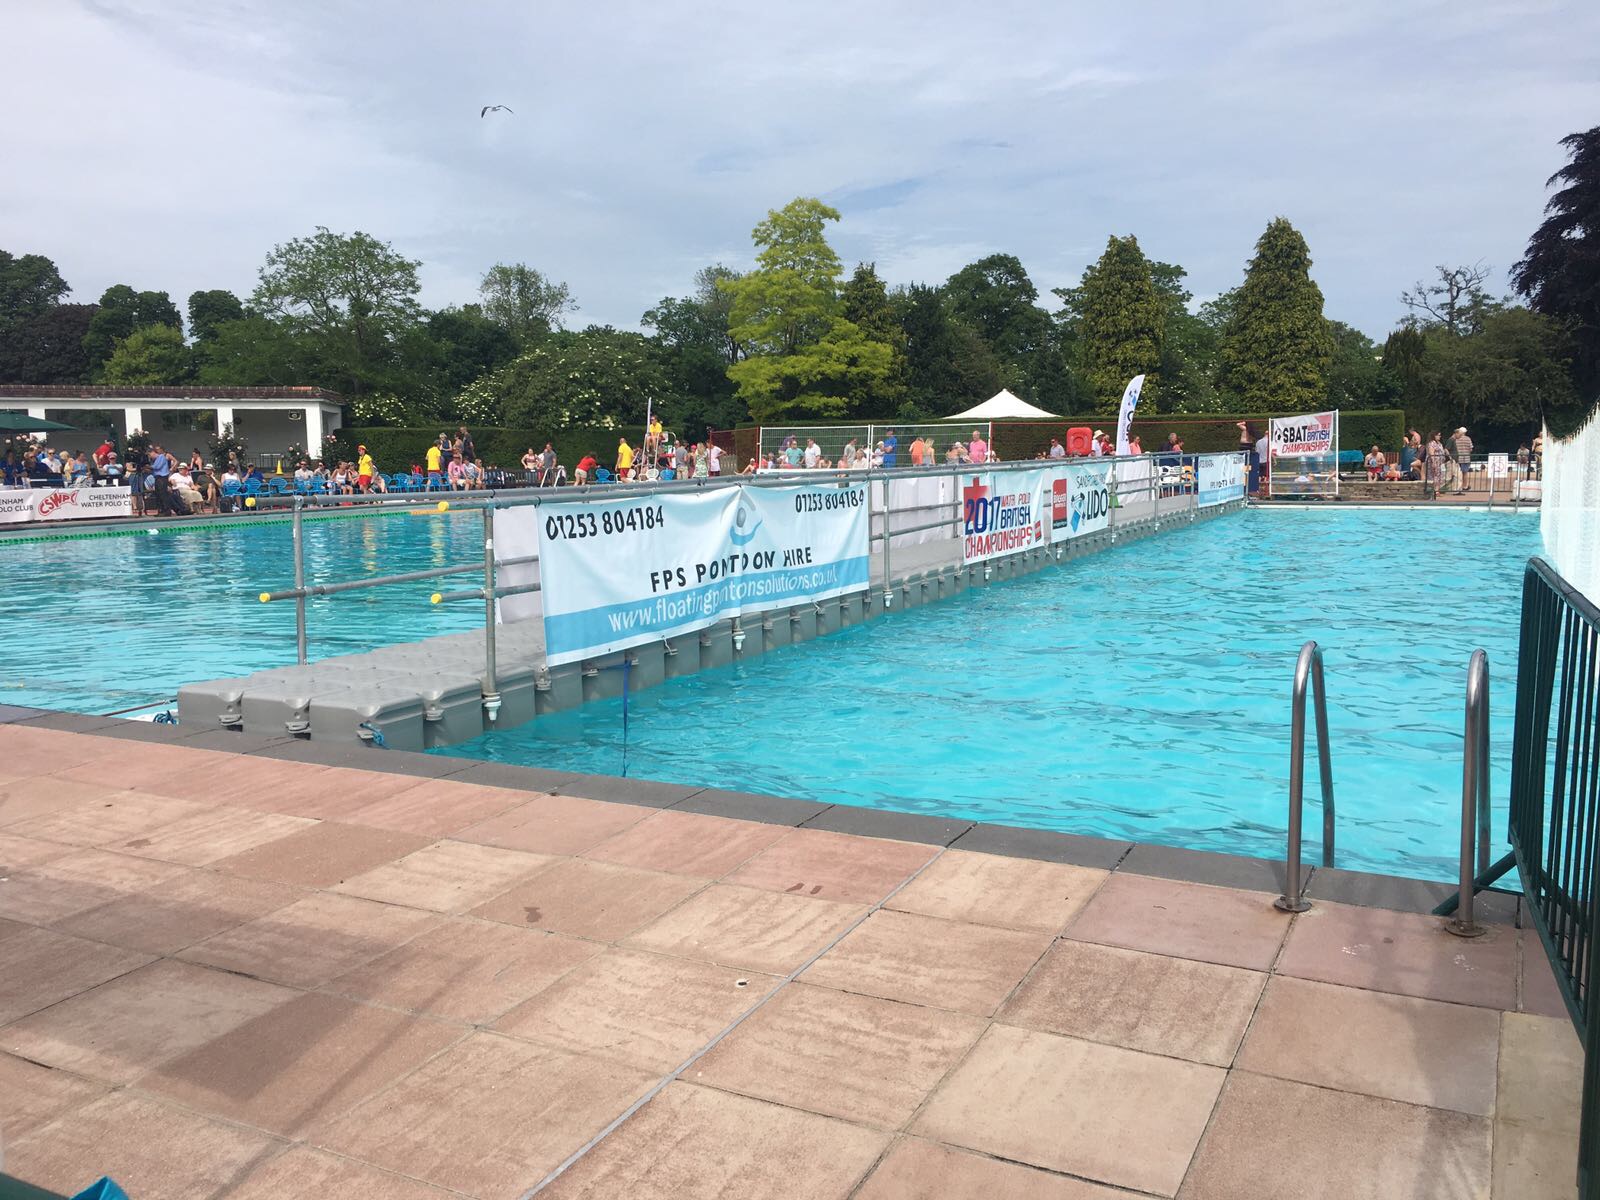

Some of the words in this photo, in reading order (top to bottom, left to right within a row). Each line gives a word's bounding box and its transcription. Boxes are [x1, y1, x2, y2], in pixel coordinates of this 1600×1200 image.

[1282, 425, 1308, 443] SBAT
[1306, 429, 1331, 441] BRITISH
[1281, 440, 1330, 454] CHAMPIONSHIPS
[15, 504, 34, 512] CLUB
[795, 493, 823, 513] 01253
[825, 489, 865, 510] 804184
[1087, 488, 1108, 520] LIDO
[545, 512, 598, 541] 01253
[602, 505, 664, 535] 804184
[965, 496, 1001, 536] 2017
[1000, 505, 1031, 529] BRITISH
[965, 526, 1033, 559] CHAMPIONSHIPS
[650, 567, 687, 593] FPS
[696, 551, 776, 584] PONTOON
[783, 546, 813, 567] HIRE
